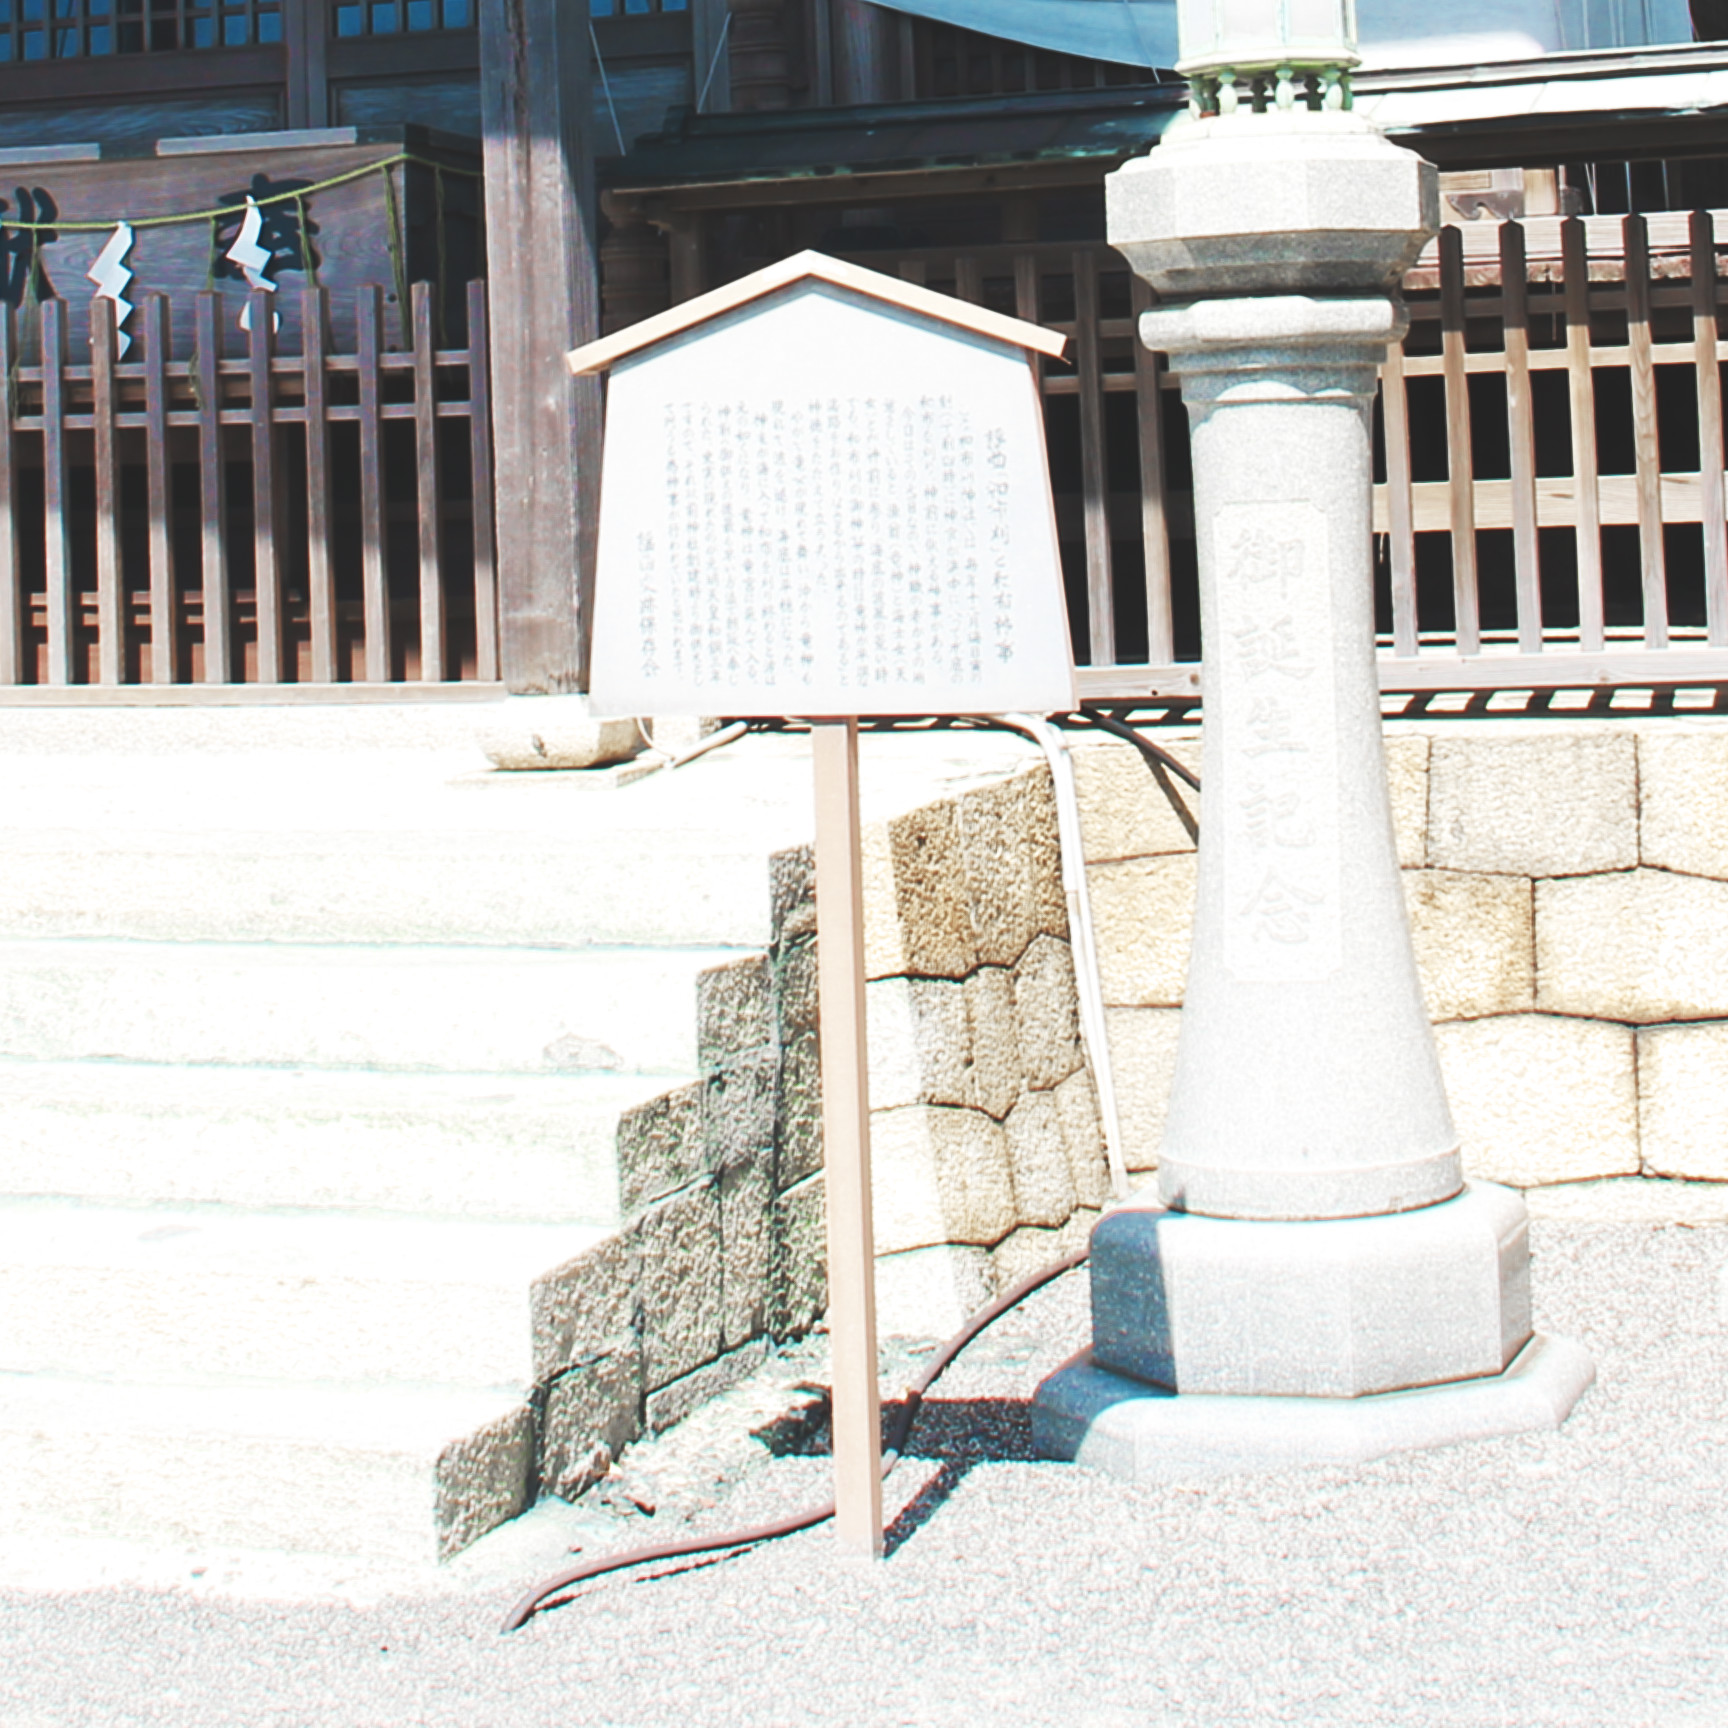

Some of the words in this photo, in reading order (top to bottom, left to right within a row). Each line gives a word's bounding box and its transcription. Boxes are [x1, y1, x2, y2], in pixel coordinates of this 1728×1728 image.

[1225, 526, 1327, 947] 御誕生記念
